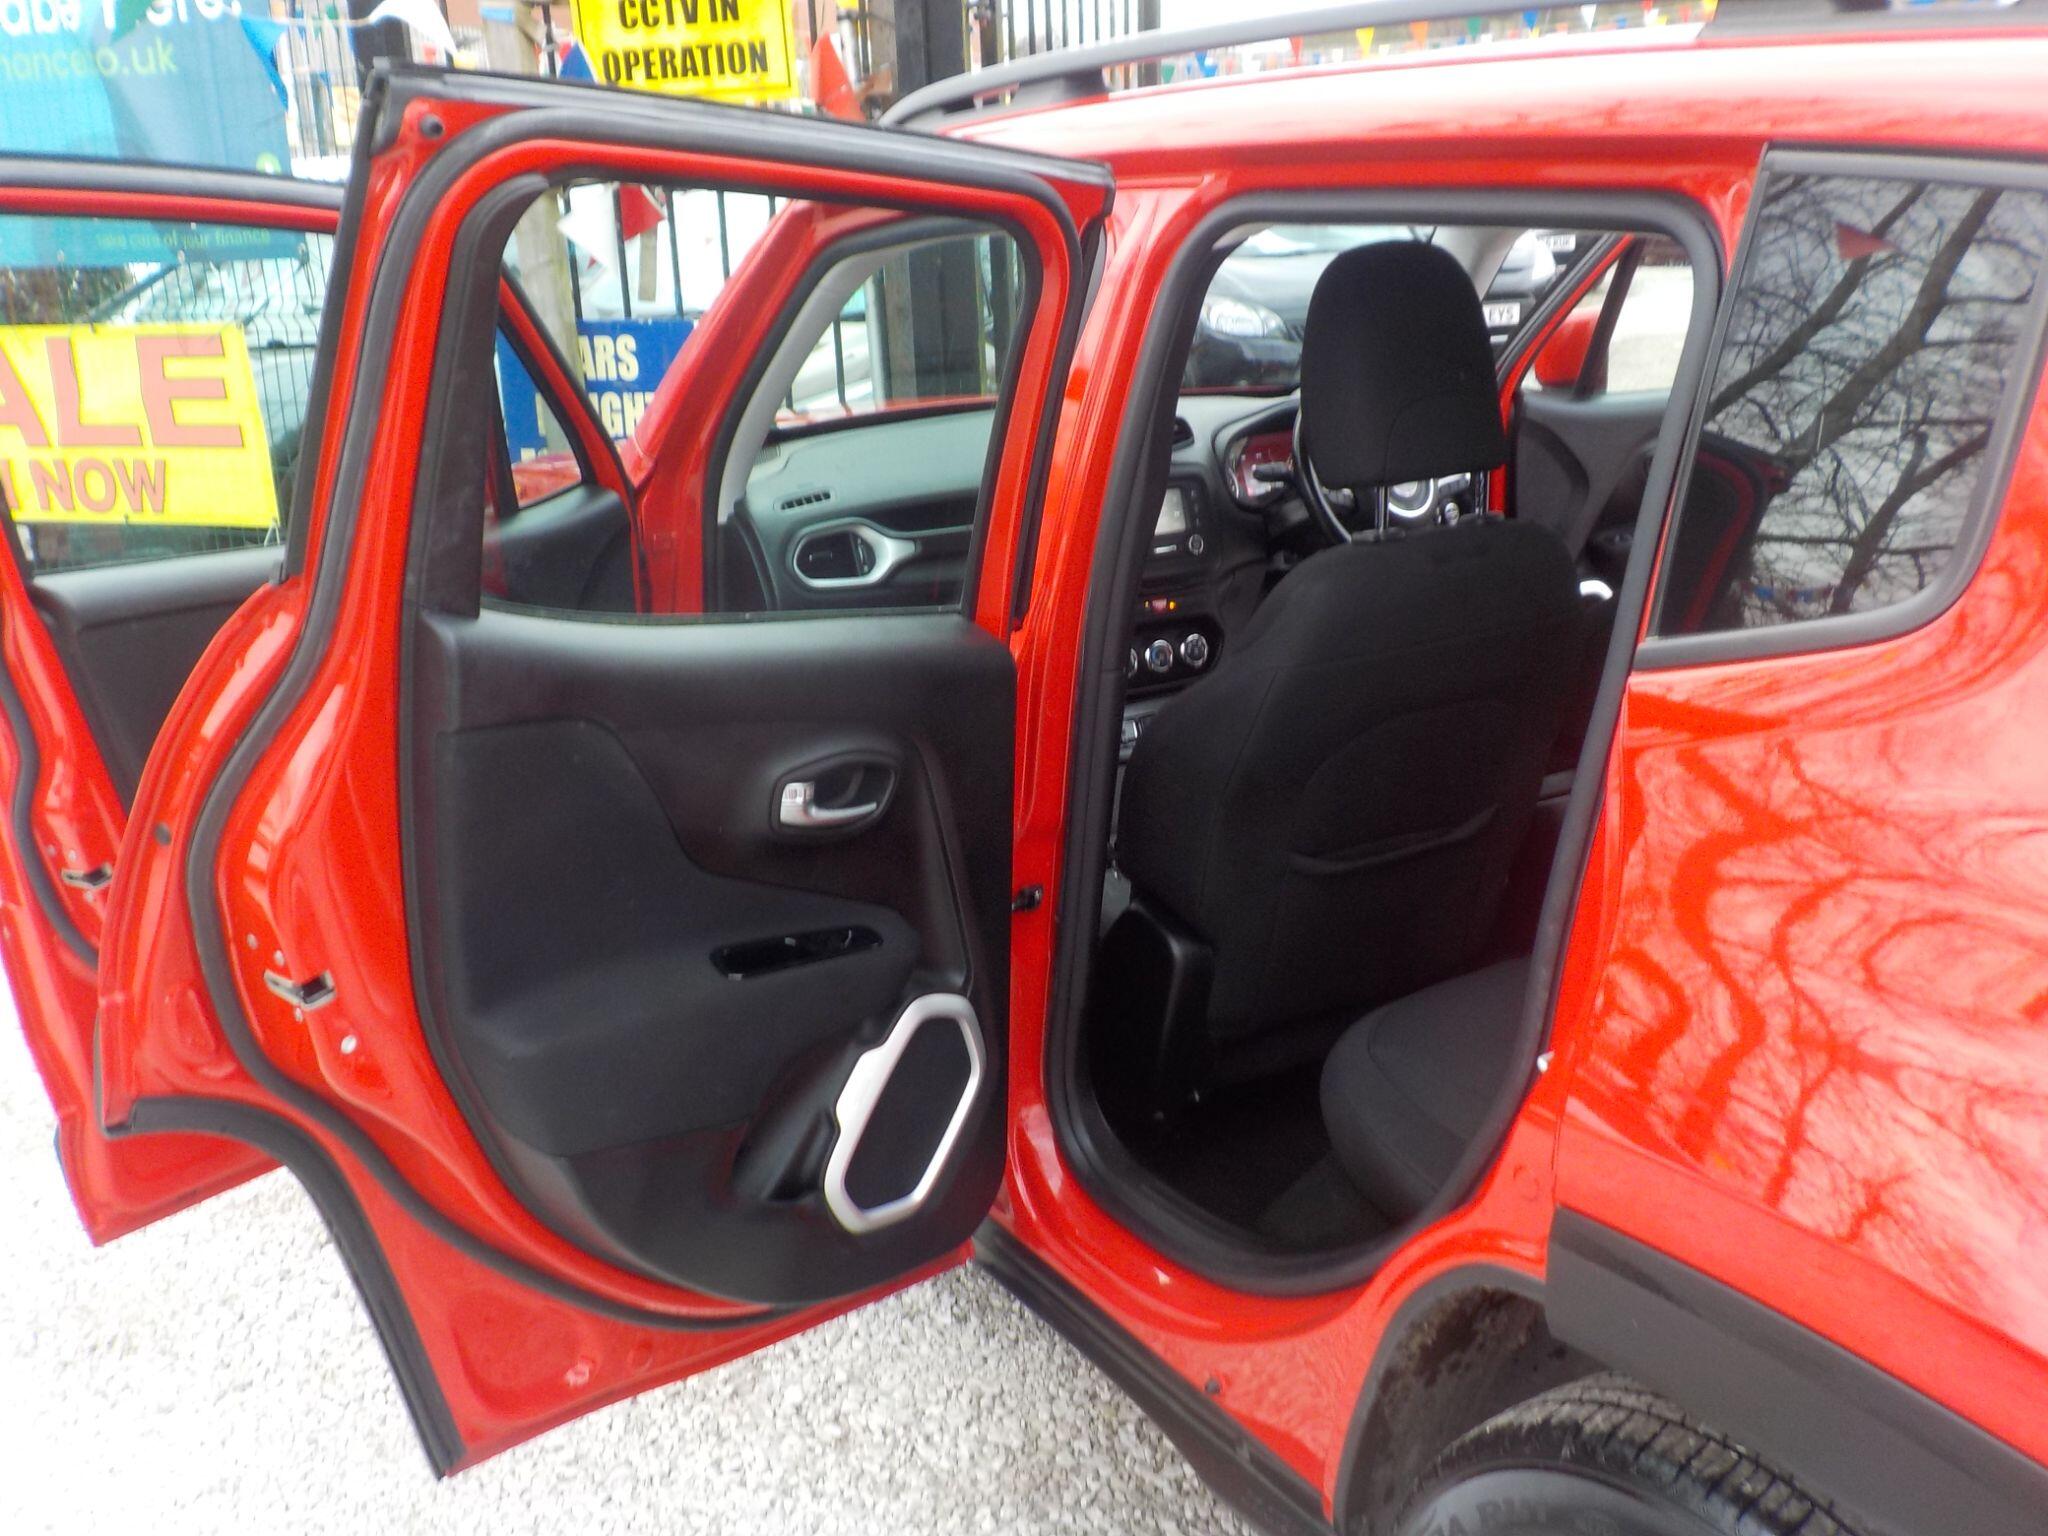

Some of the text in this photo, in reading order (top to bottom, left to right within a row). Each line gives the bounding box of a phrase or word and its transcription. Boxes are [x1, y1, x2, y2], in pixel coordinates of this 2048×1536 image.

[618, 0, 740, 29] CCTV IN
[602, 40, 769, 82] OPERATION
[28, 457, 166, 514] NOW
